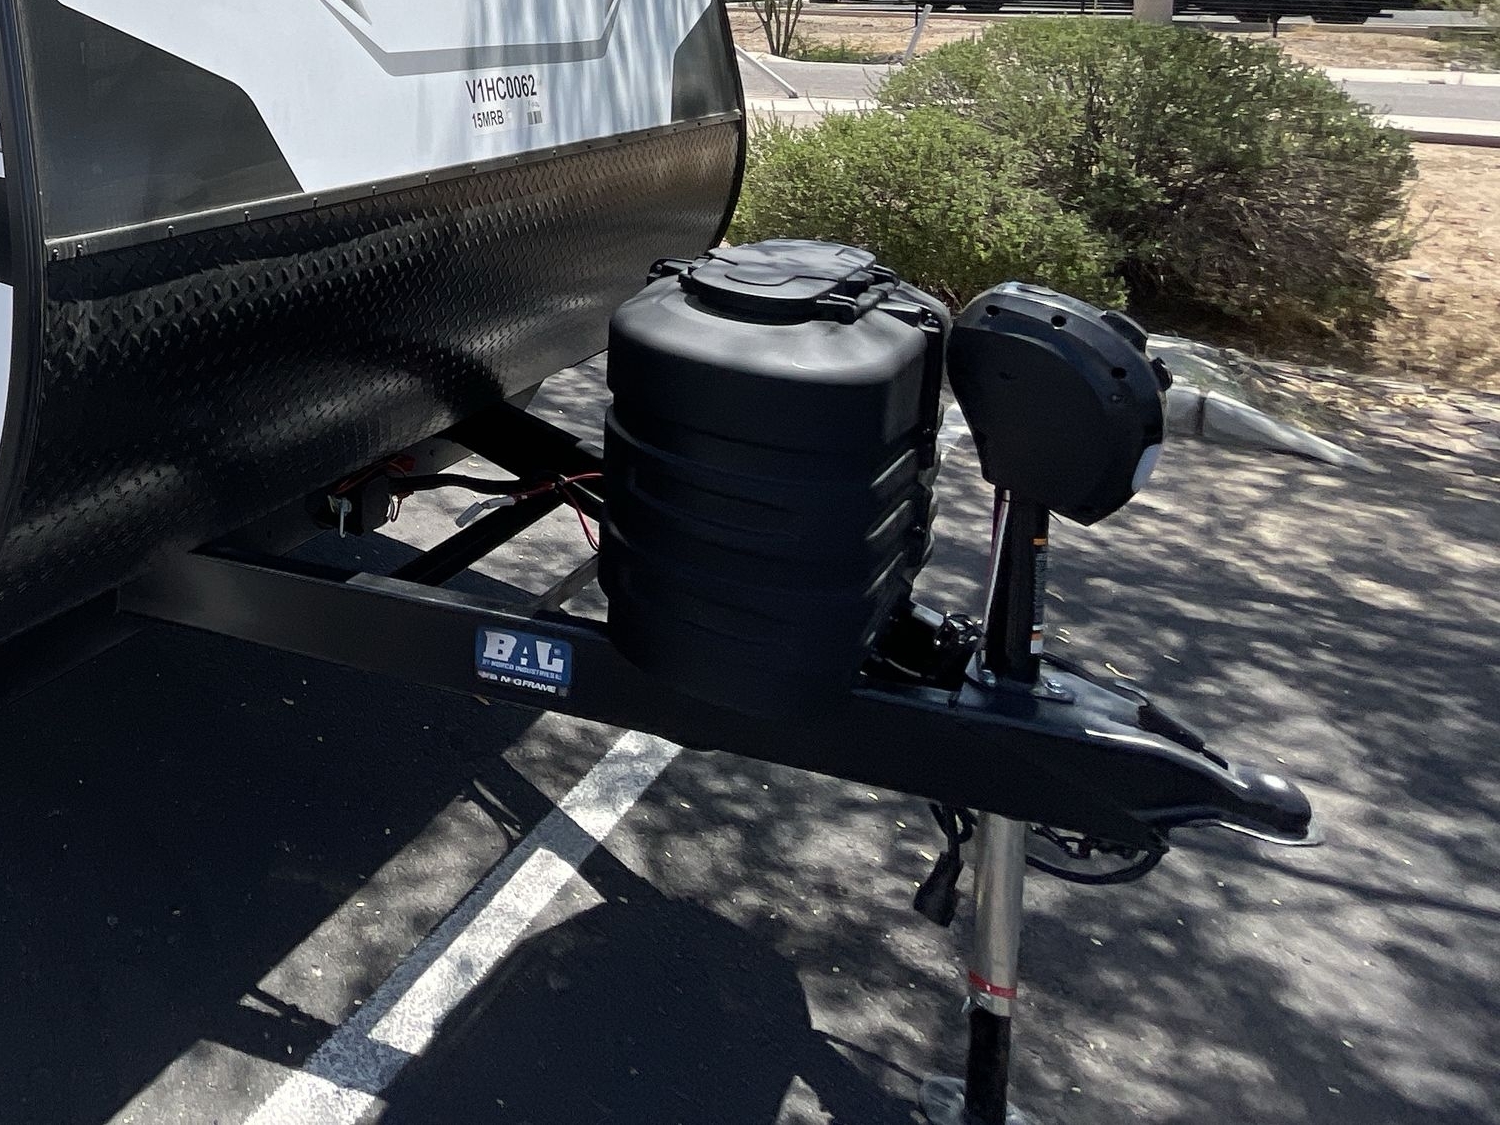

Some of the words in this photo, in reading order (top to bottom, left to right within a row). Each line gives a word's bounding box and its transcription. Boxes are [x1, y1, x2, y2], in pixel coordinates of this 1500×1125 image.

[465, 74, 537, 103] V1HC0062
[472, 110, 504, 128] 15MRB
[483, 630, 564, 673] BAL
